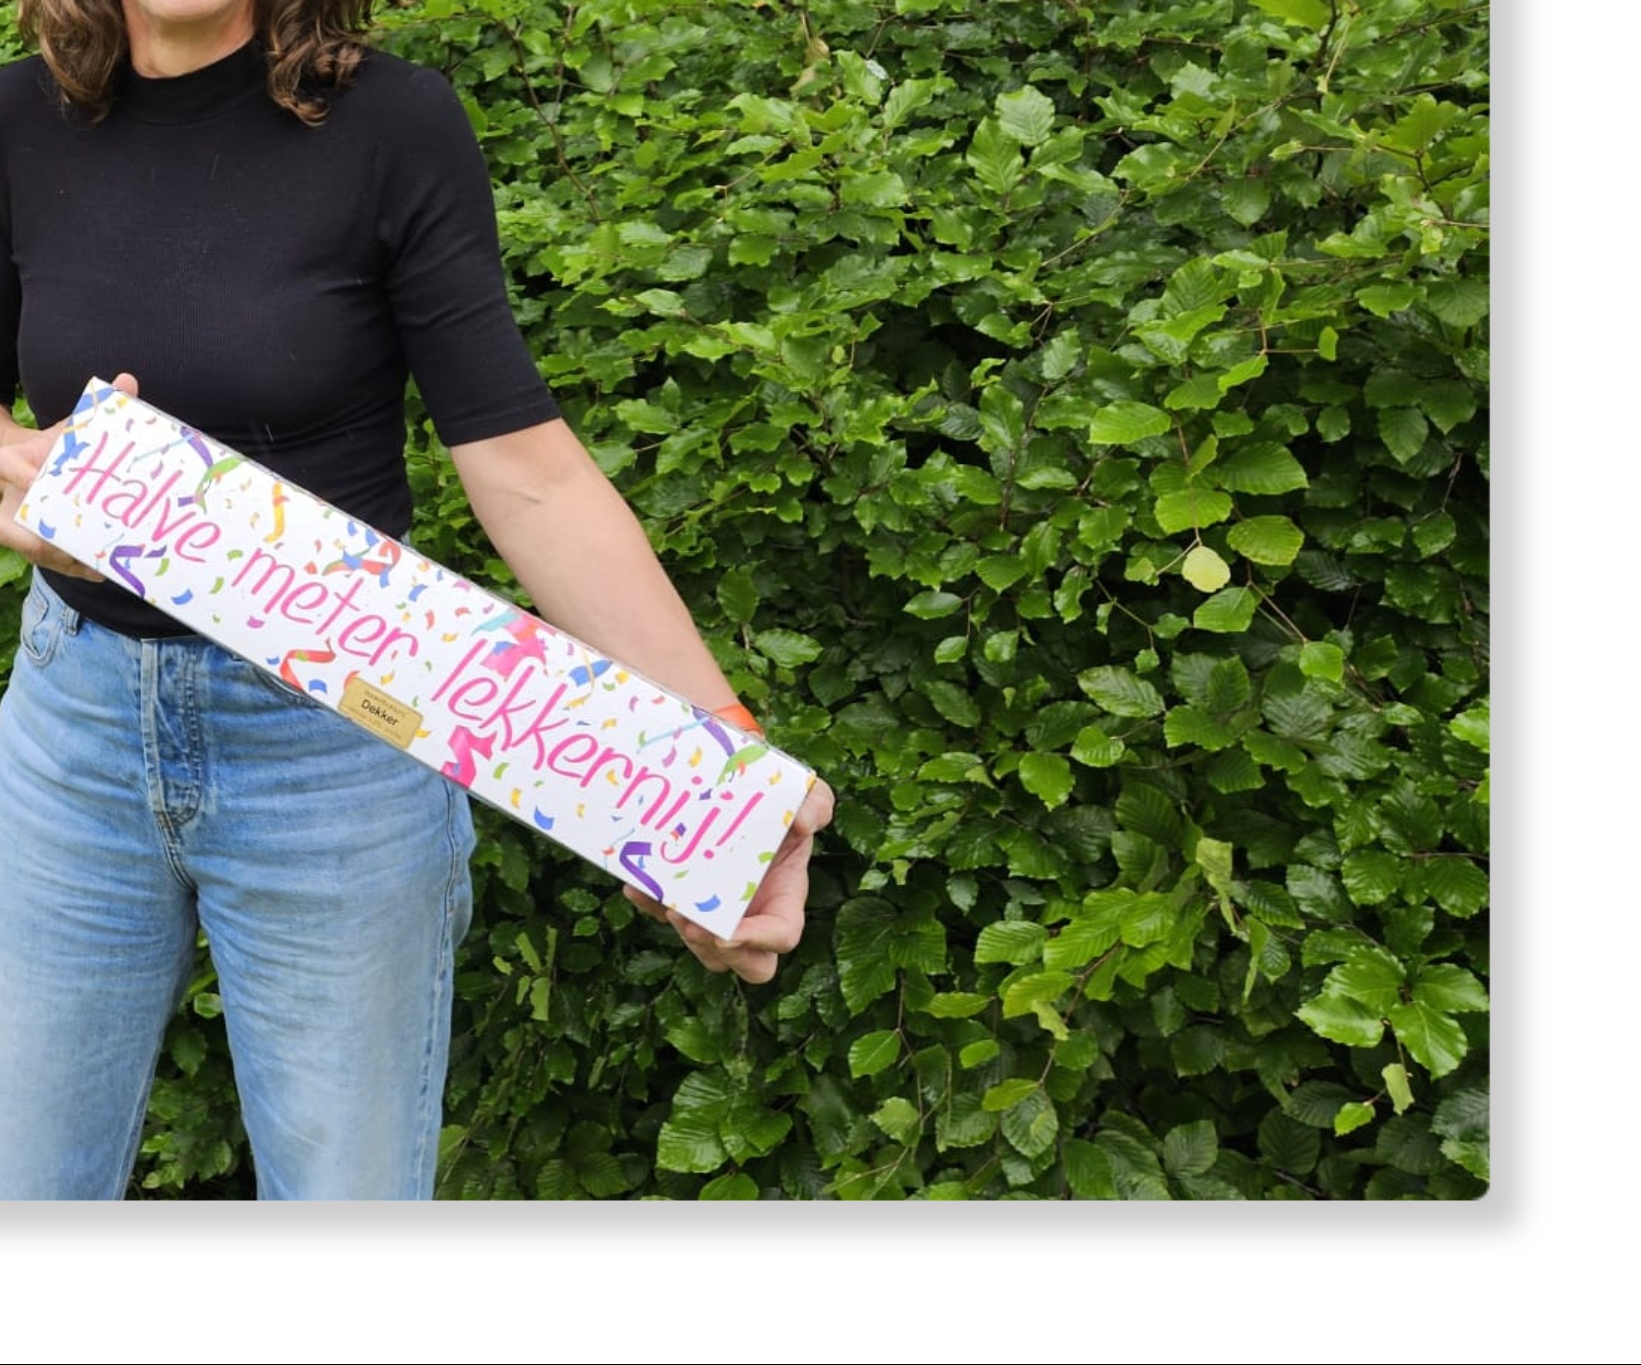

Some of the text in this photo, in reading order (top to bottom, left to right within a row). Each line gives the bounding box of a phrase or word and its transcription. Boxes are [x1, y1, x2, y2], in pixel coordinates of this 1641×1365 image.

[62, 431, 764, 865] Halve meter lekkernij!
[361, 699, 399, 726] Dekker
